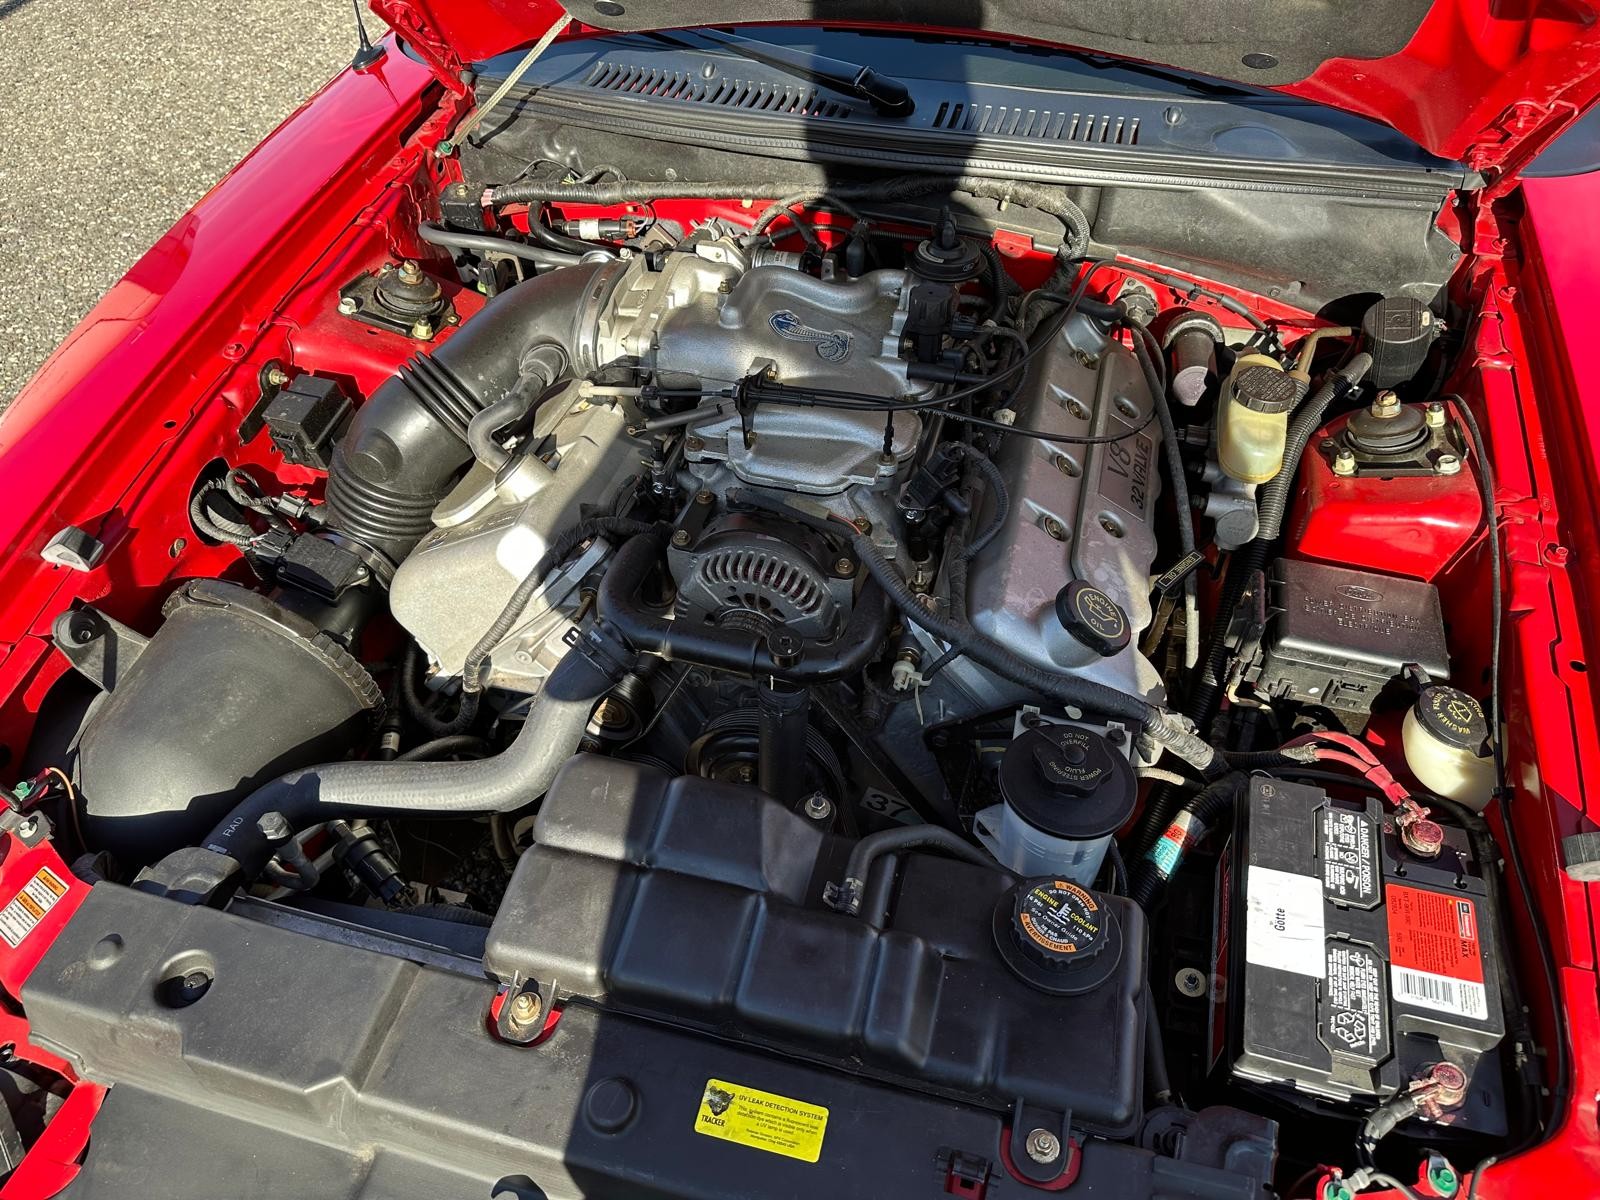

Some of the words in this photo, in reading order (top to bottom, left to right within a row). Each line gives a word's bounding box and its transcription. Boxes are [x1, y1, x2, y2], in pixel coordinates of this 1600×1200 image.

[1108, 441, 1130, 478] V8
[1132, 438, 1148, 486] VALVE
[1130, 486, 1144, 510] 32
[1175, 556, 1196, 573] ENGINE
[1165, 572, 1176, 580] OIL
[1089, 594, 1116, 616] ENGINE
[1091, 618, 1104, 630] OIL
[1433, 693, 1444, 710] FLUID
[1468, 701, 1484, 718] ONLY
[1437, 713, 1470, 734] WASHER
[1061, 739, 1090, 750] OVERFILL
[1049, 762, 1078, 780] STEERING
[1080, 768, 1101, 780] POWER
[223, 816, 244, 837] RAD
[1360, 828, 1369, 858] DANGER
[1361, 865, 1371, 894] POISON
[1034, 889, 1059, 907] ENGINE
[1066, 884, 1095, 909] WARNING
[1072, 895, 1085, 907] OPEN
[1031, 908, 1041, 916] See
[1043, 915, 1060, 928] Owner
[1061, 928, 1078, 940] Guide
[1070, 913, 1098, 932] COOLANT
[1025, 922, 1072, 950] AVERTISSEMENT
[1083, 932, 1093, 940] kPa
[1460, 940, 1469, 958] MAX
[748, 1097, 764, 1106] LEAK
[764, 1102, 798, 1115] DETECTION
[798, 1110, 824, 1122] SYSTEM
[701, 1114, 726, 1127] TRACKER
